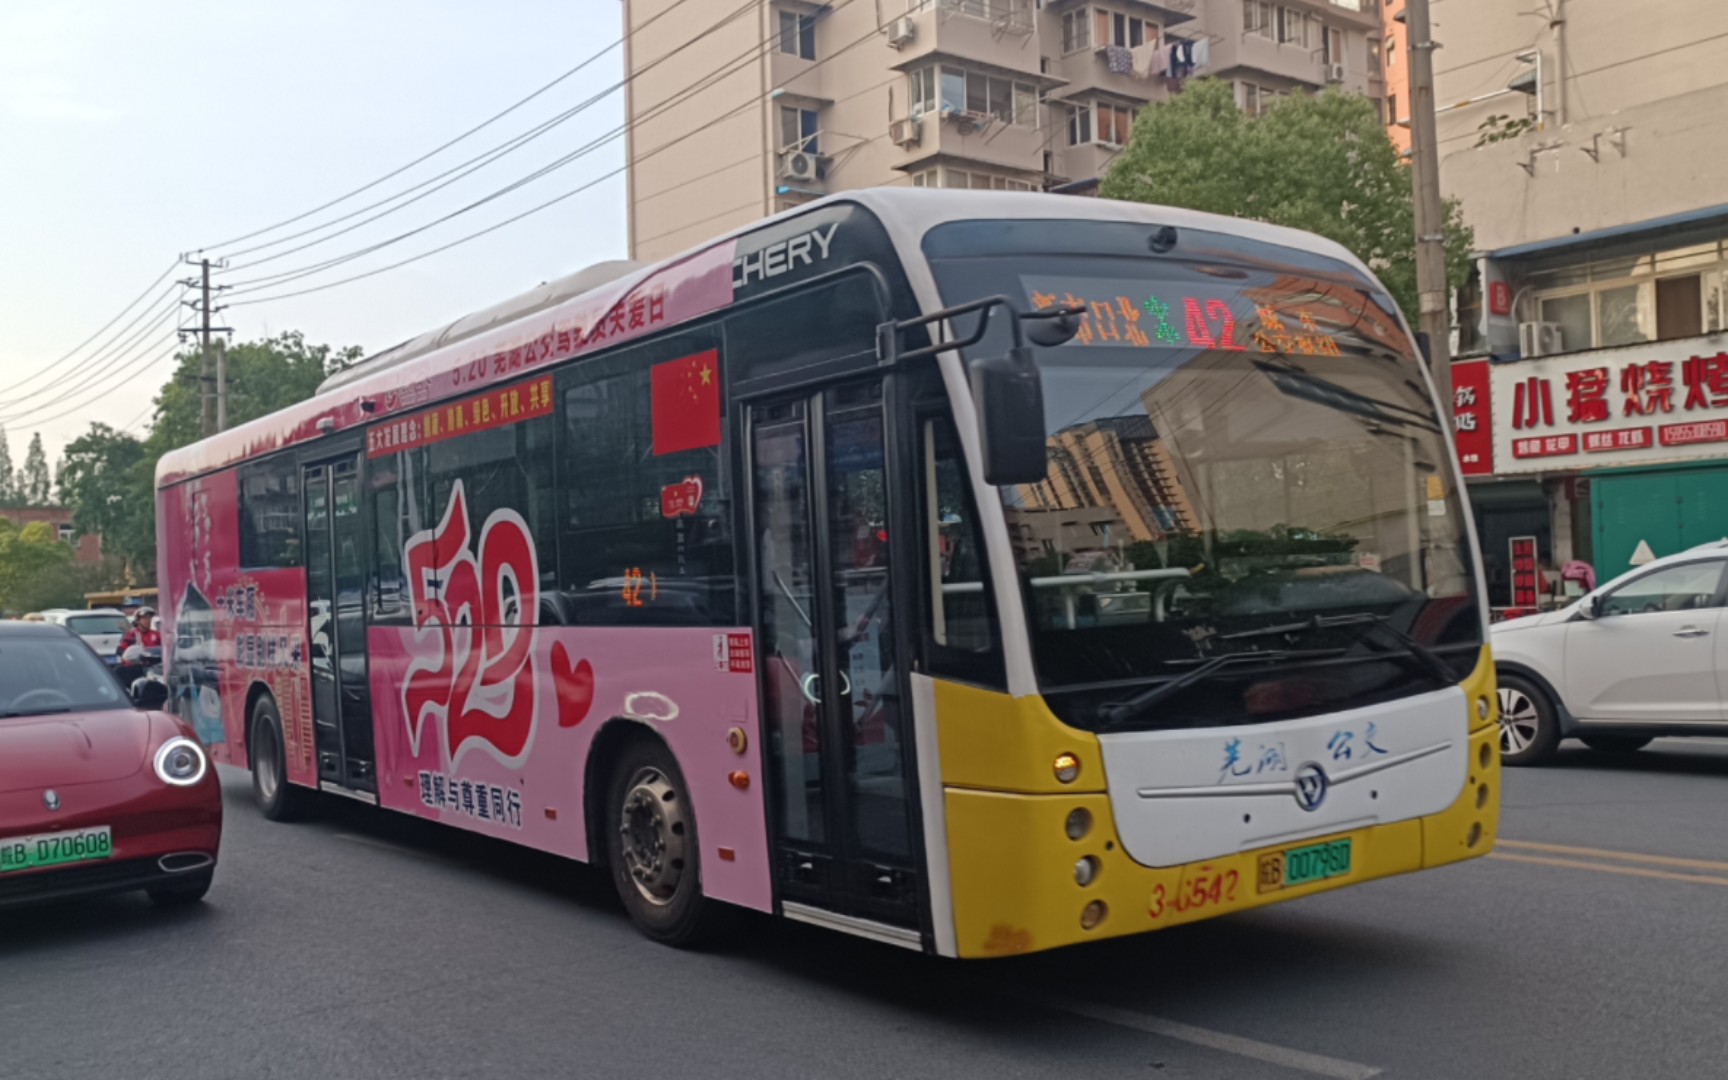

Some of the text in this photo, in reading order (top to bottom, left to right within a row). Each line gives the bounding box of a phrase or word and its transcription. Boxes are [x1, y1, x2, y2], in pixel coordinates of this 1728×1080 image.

[1183, 296, 1247, 353] 42
[1217, 720, 1390, 784] 芜湖 公交
[419, 771, 522, 828] 理解与尊重同行
